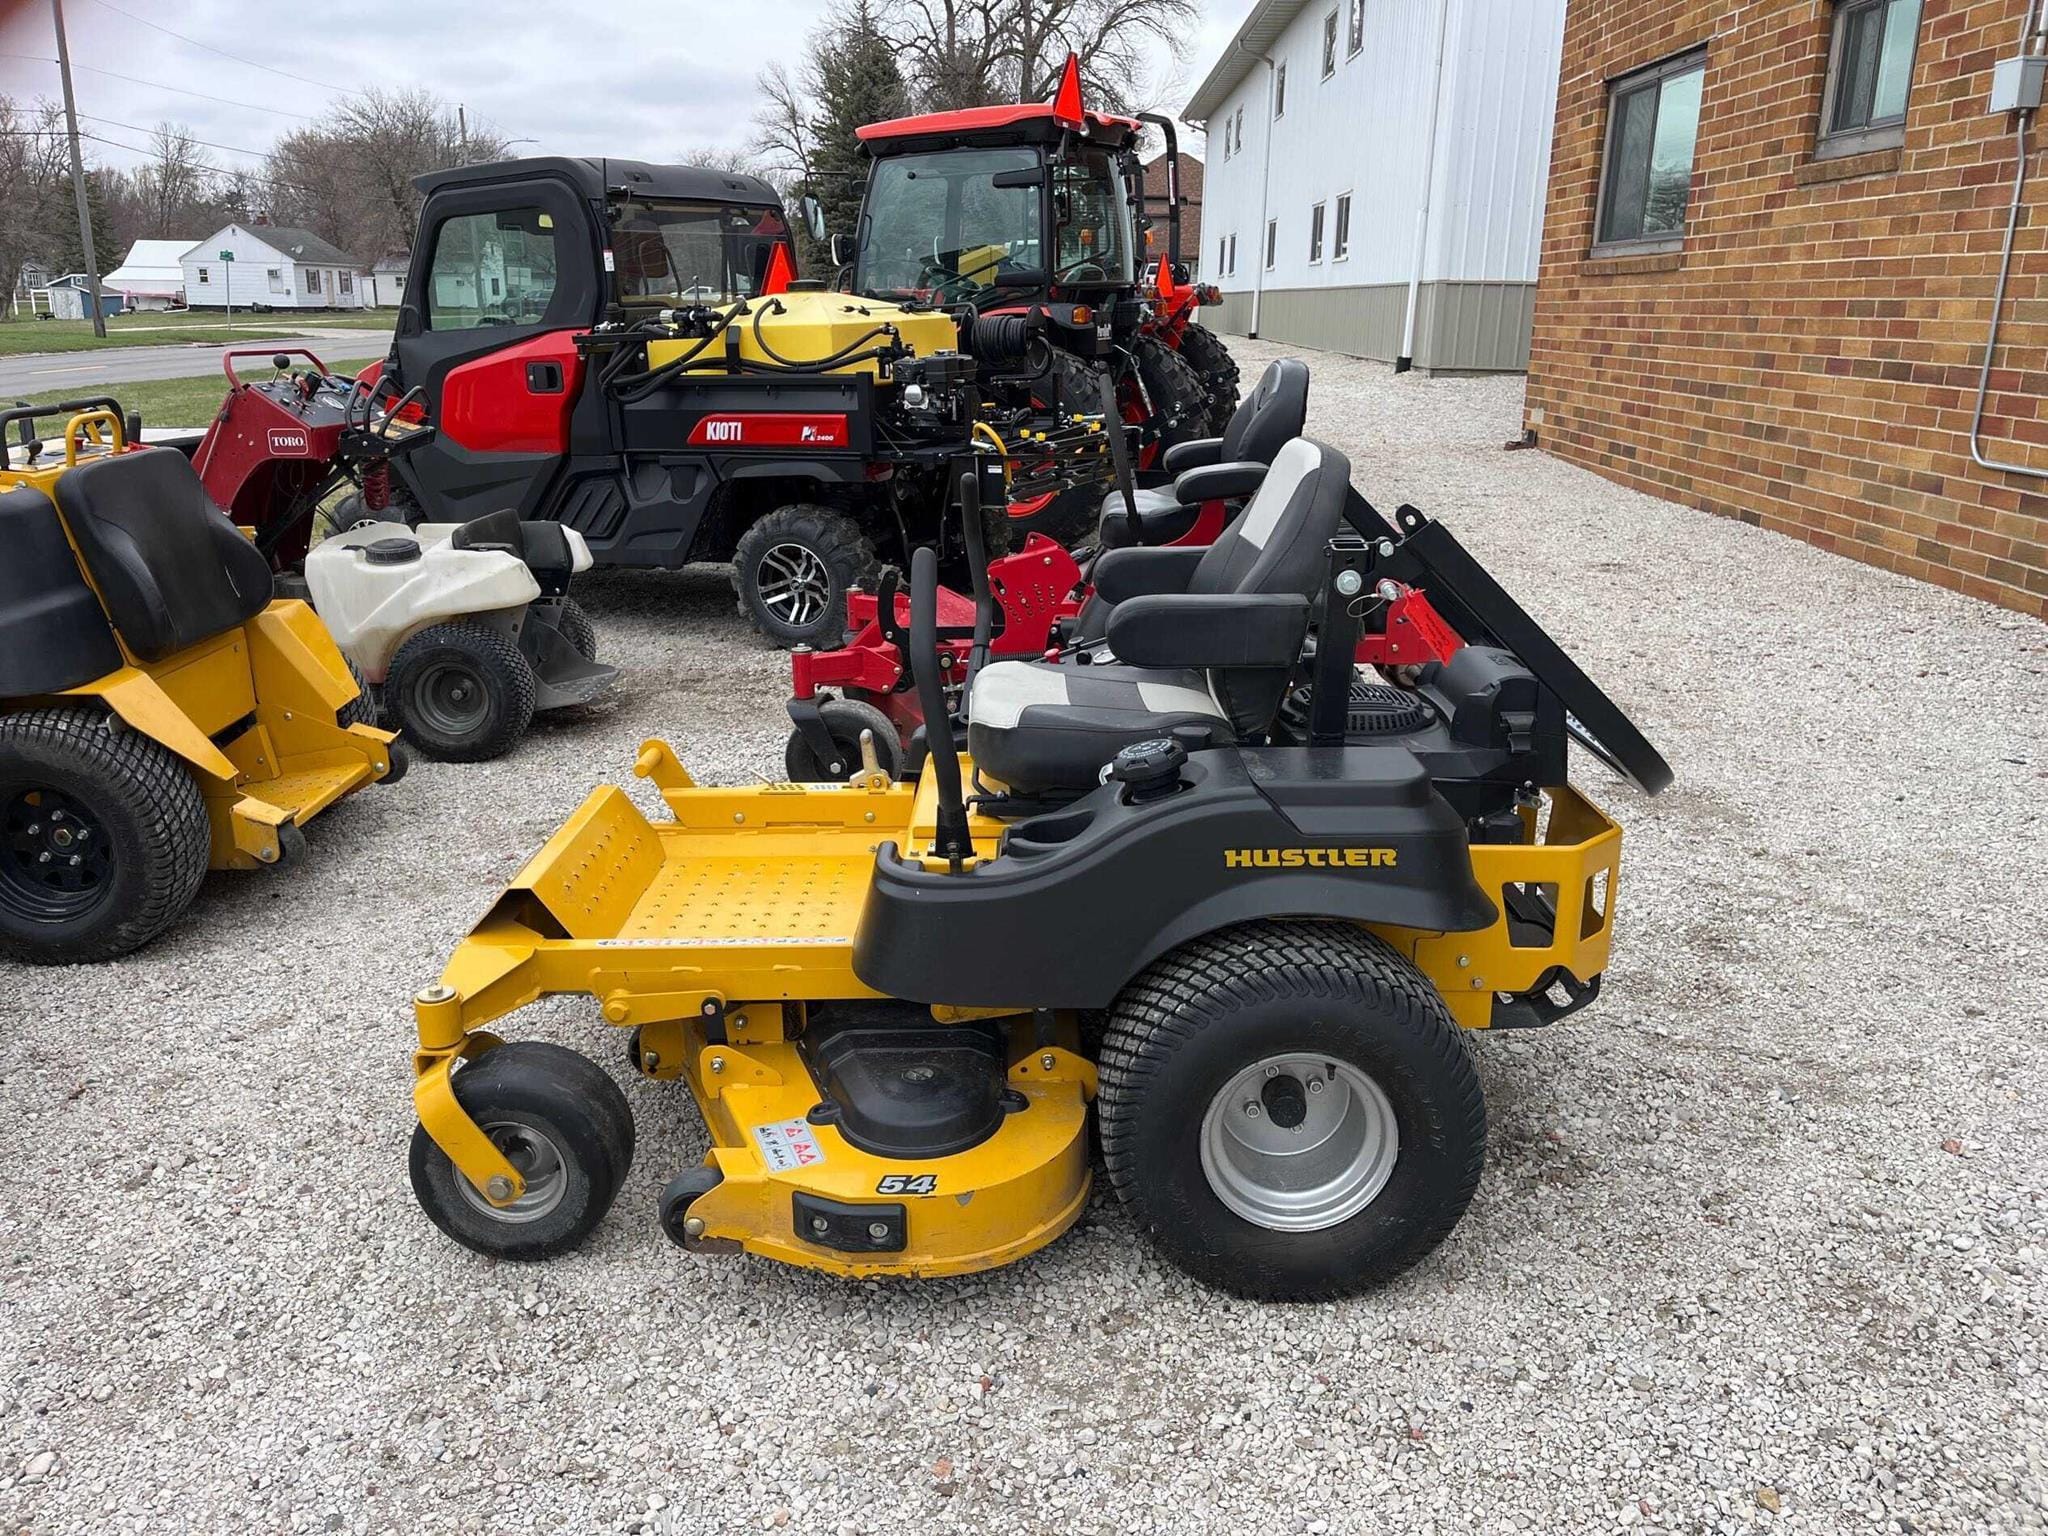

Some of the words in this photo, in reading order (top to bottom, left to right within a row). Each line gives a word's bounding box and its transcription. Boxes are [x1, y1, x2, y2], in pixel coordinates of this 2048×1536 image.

[706, 421, 742, 441] KIOTI
[816, 434, 834, 442] 2400
[271, 436, 304, 447] TORO
[1224, 848, 1397, 868] HUSTLER
[876, 1174, 937, 1195] 54
